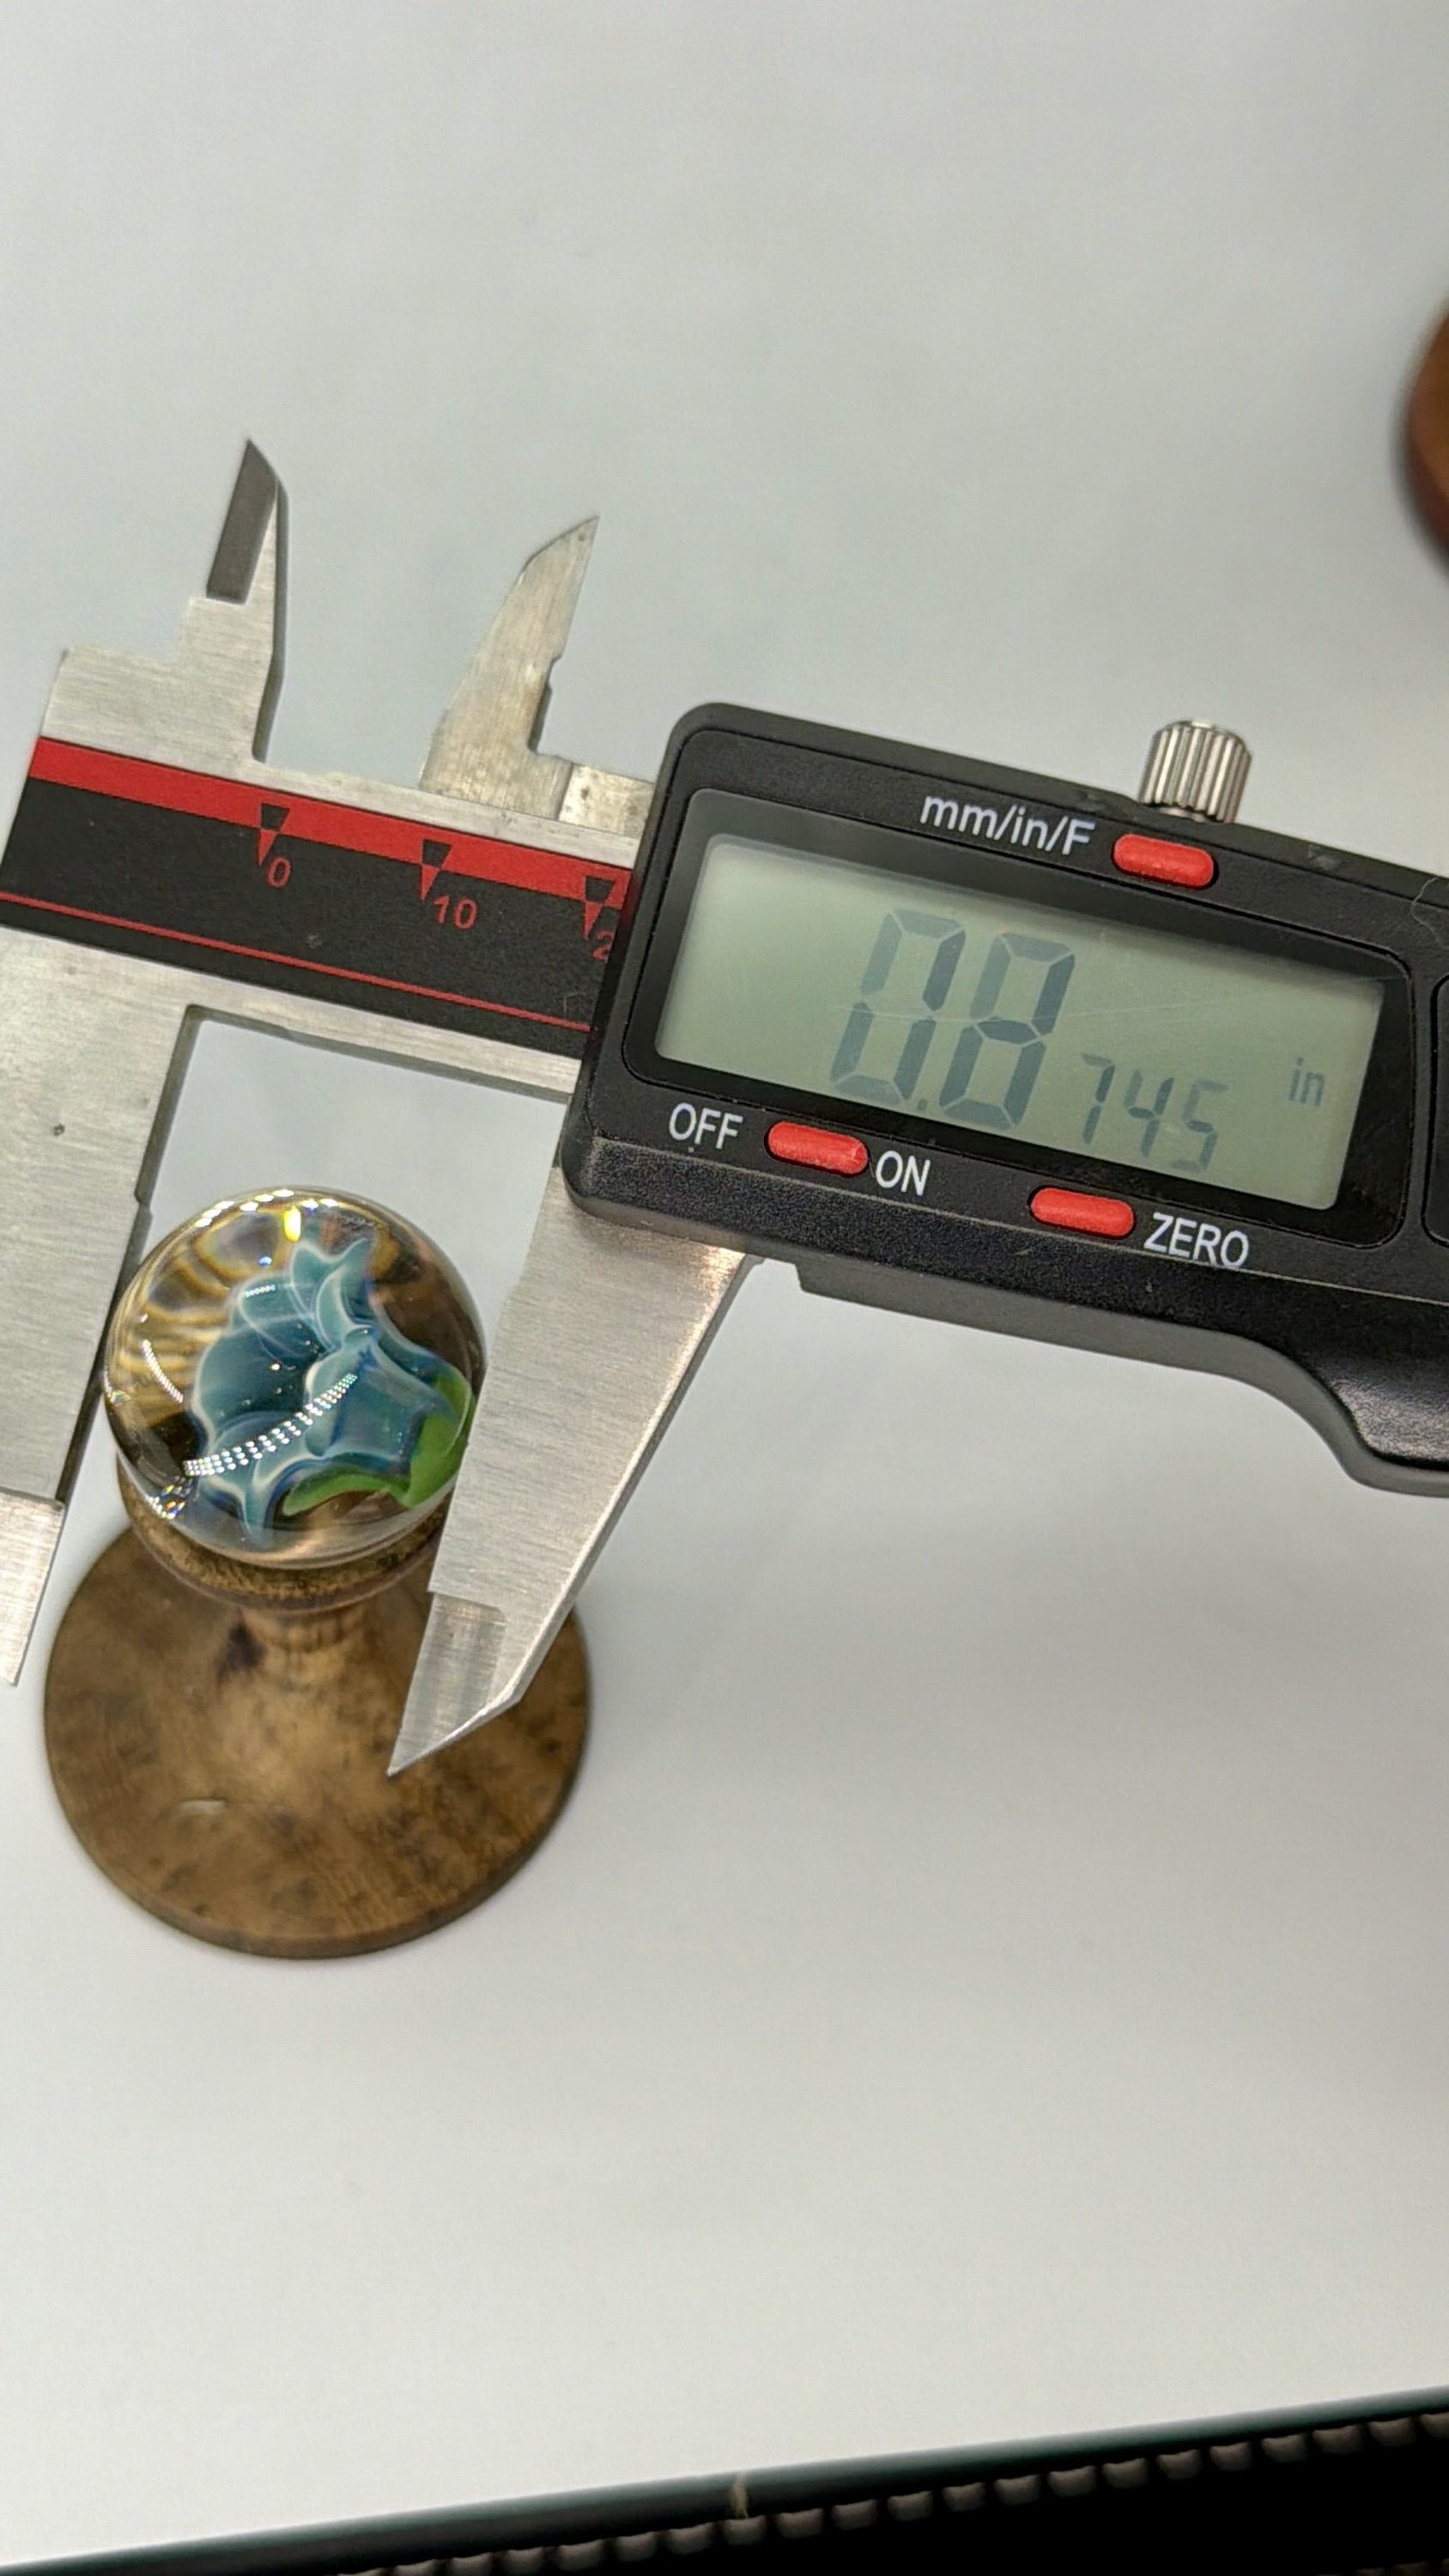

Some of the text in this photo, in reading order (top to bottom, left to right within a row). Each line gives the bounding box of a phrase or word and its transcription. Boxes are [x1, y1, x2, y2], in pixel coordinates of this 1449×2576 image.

[920, 793, 1095, 856] mm/in/F
[267, 858, 614, 962] 0 10 2
[1288, 1057, 1326, 1108] in
[668, 1103, 931, 1196] OFF ON
[1145, 1212, 1250, 1269] ZERO
